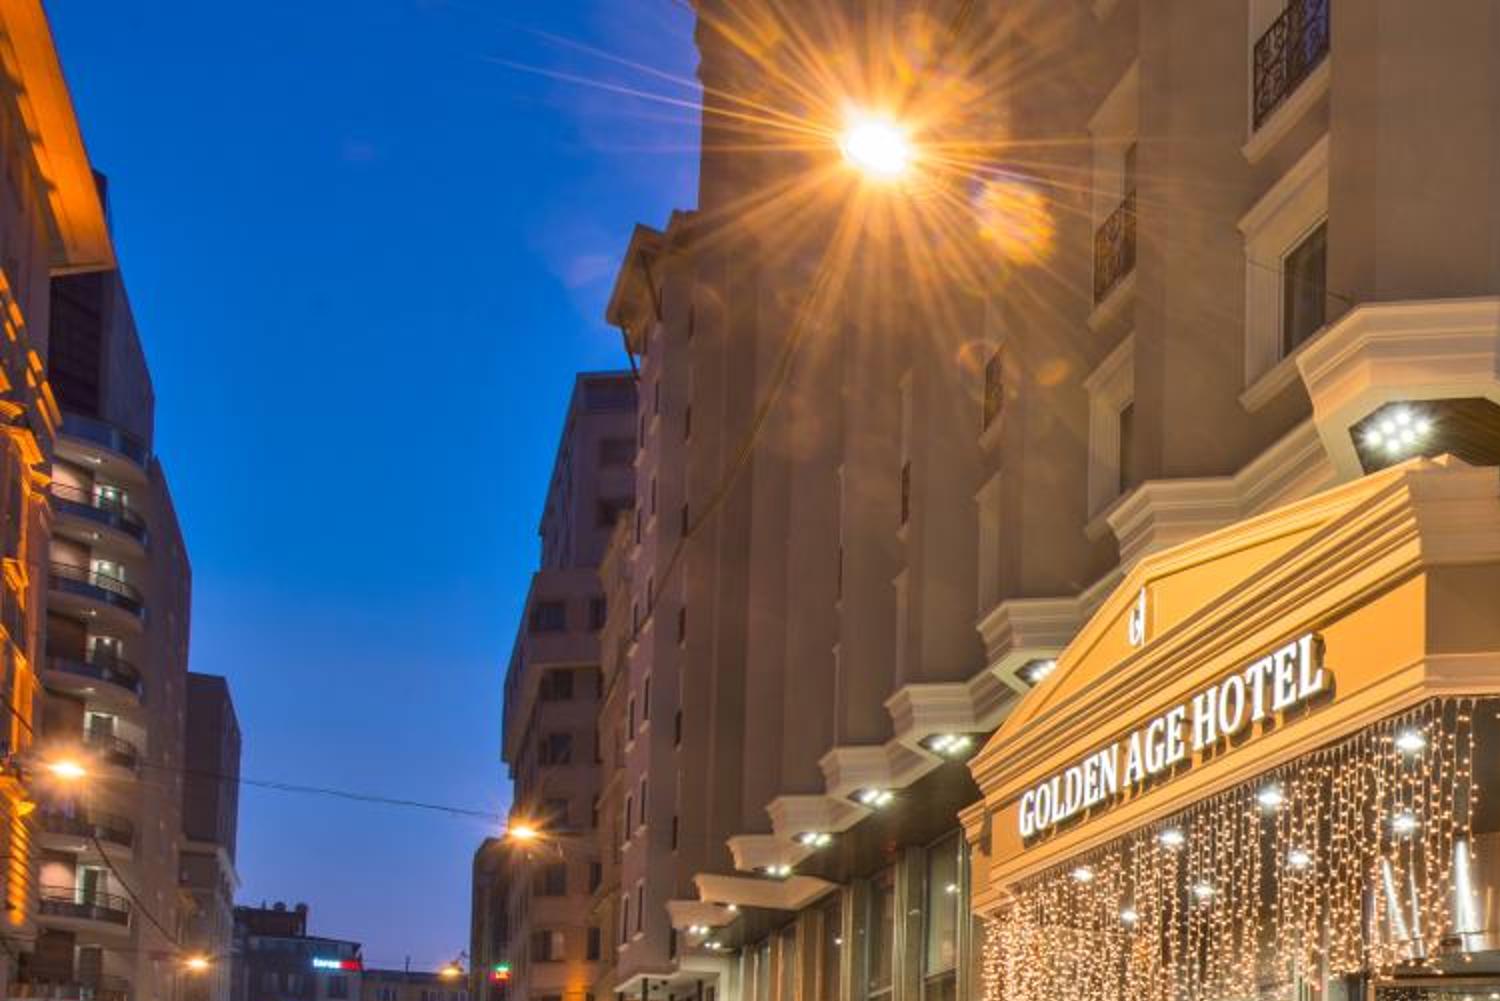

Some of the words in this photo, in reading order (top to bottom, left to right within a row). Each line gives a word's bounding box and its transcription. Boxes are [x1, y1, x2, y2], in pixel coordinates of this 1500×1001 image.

[1018, 741, 1119, 837] GOLDEN
[1121, 704, 1185, 787] AGE
[1191, 632, 1323, 750] HOTEL
